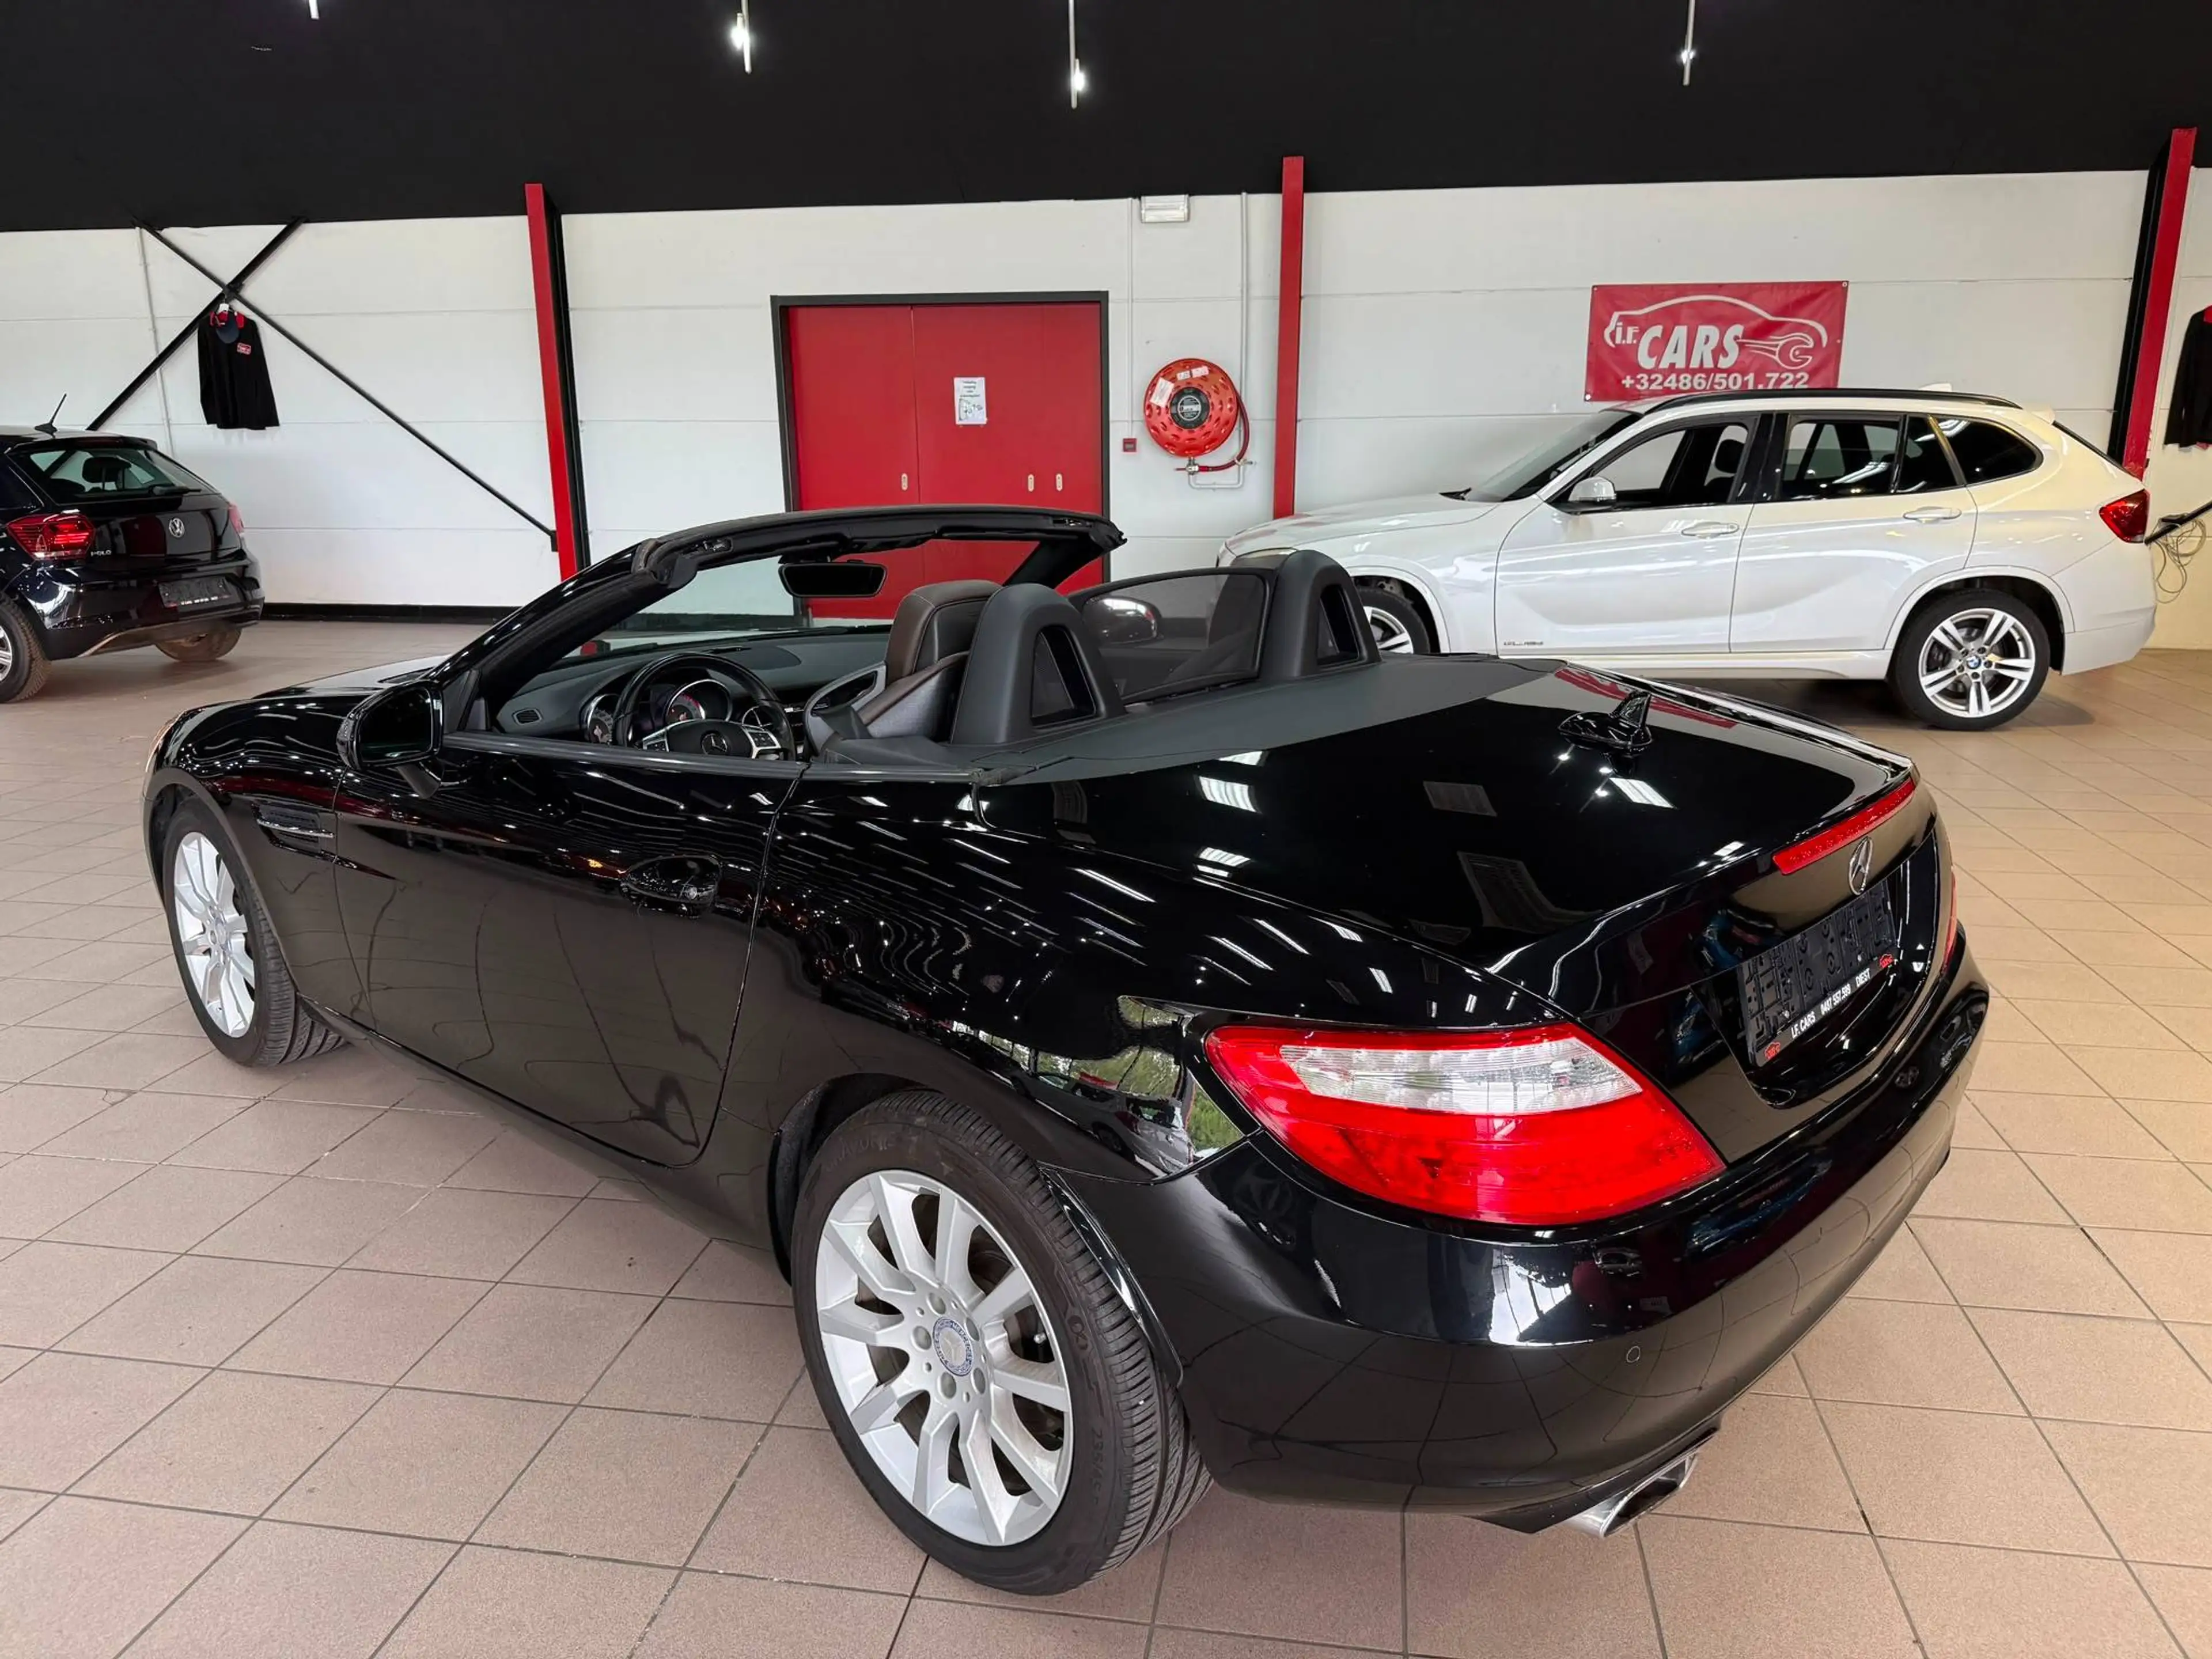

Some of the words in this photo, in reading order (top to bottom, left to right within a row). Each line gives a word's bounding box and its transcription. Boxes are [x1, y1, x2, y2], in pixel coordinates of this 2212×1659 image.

[1637, 324, 1745, 370] CARS
[1621, 372, 1809, 391] +32486/501.722
[1800, 1010, 1816, 1032] CARS
[1855, 967, 1870, 987] DIEST
